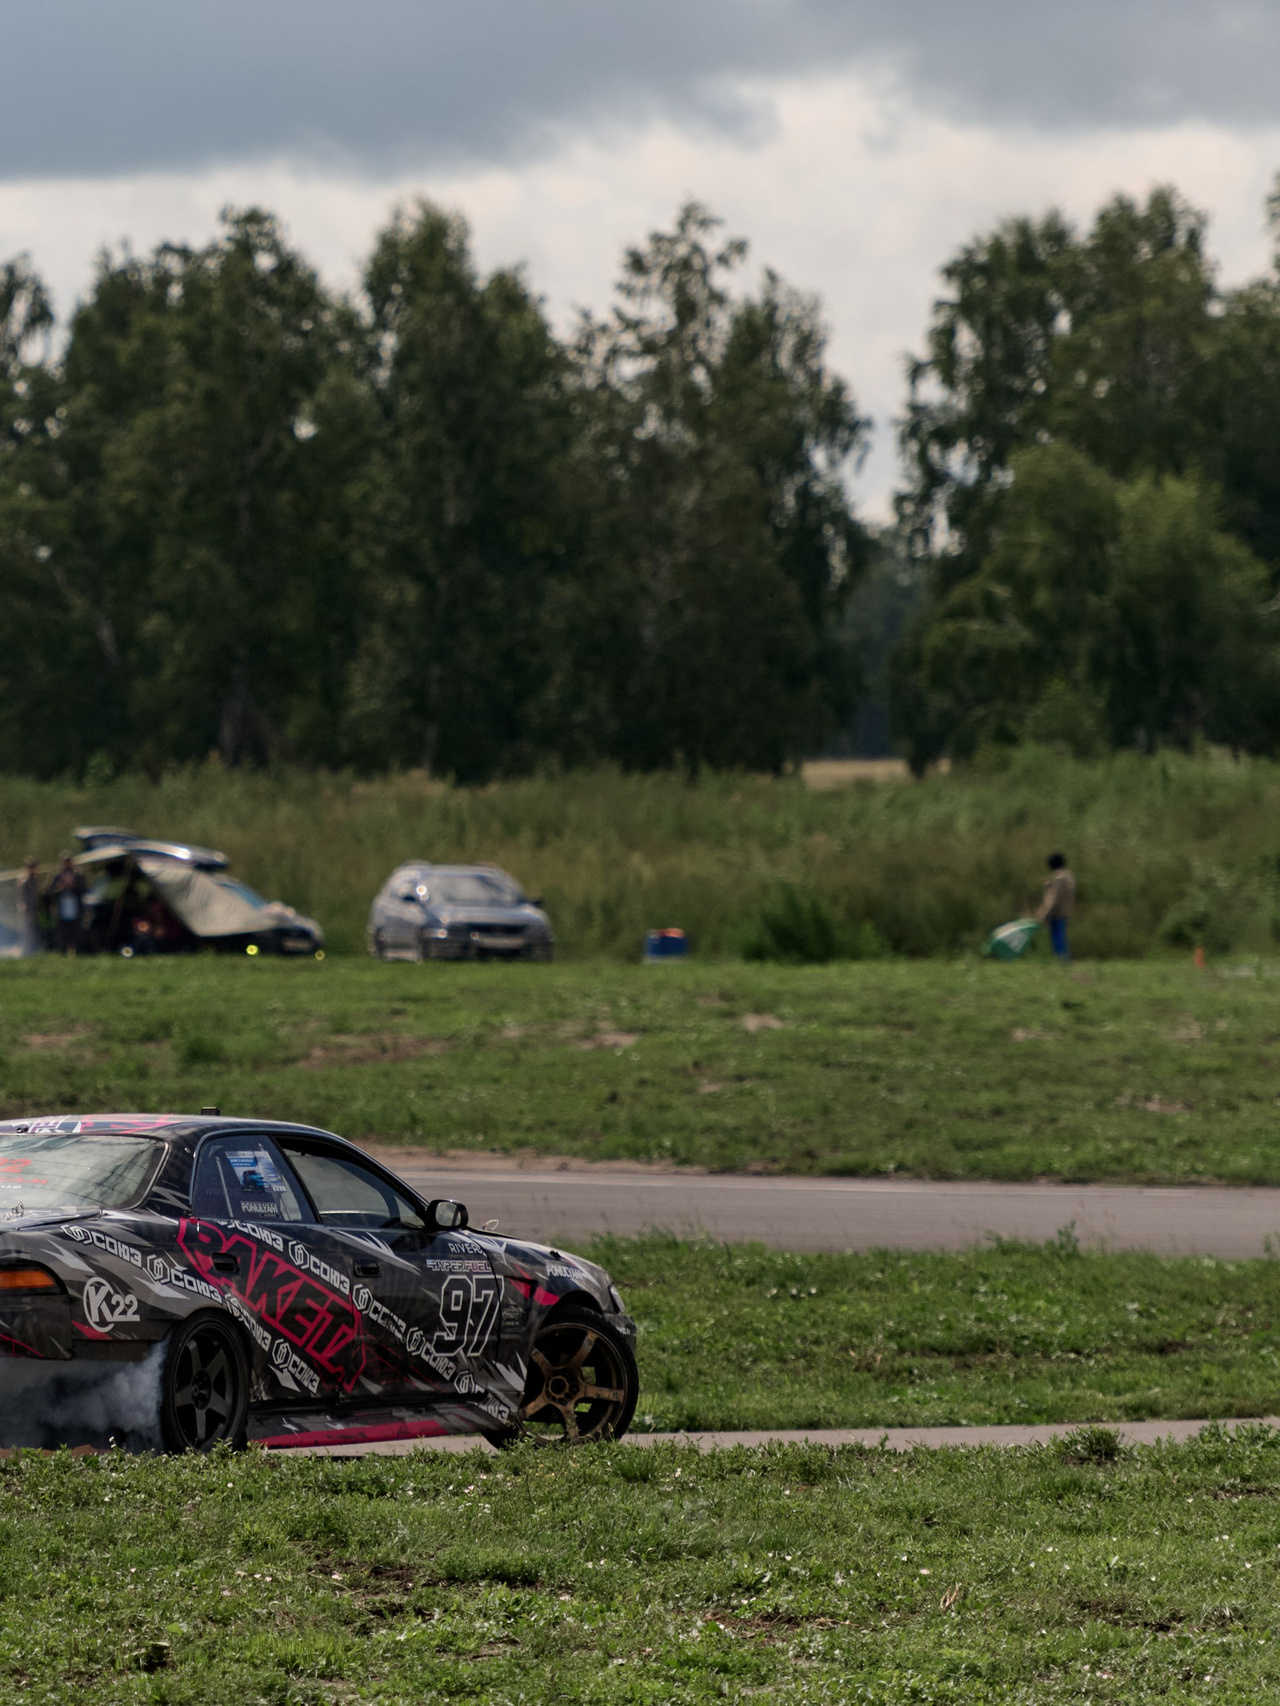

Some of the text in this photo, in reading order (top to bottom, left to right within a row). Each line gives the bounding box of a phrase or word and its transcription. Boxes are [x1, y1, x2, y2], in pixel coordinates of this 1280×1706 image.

[84, 1279, 141, 1329] K22
[310, 1254, 350, 1295] СОЮЗ
[91, 1231, 142, 1268] СОЮЗ
[171, 1268, 223, 1304] СОЮЗ
[289, 1354, 320, 1394] СОЮЗ
[432, 1275, 504, 1356] 97
